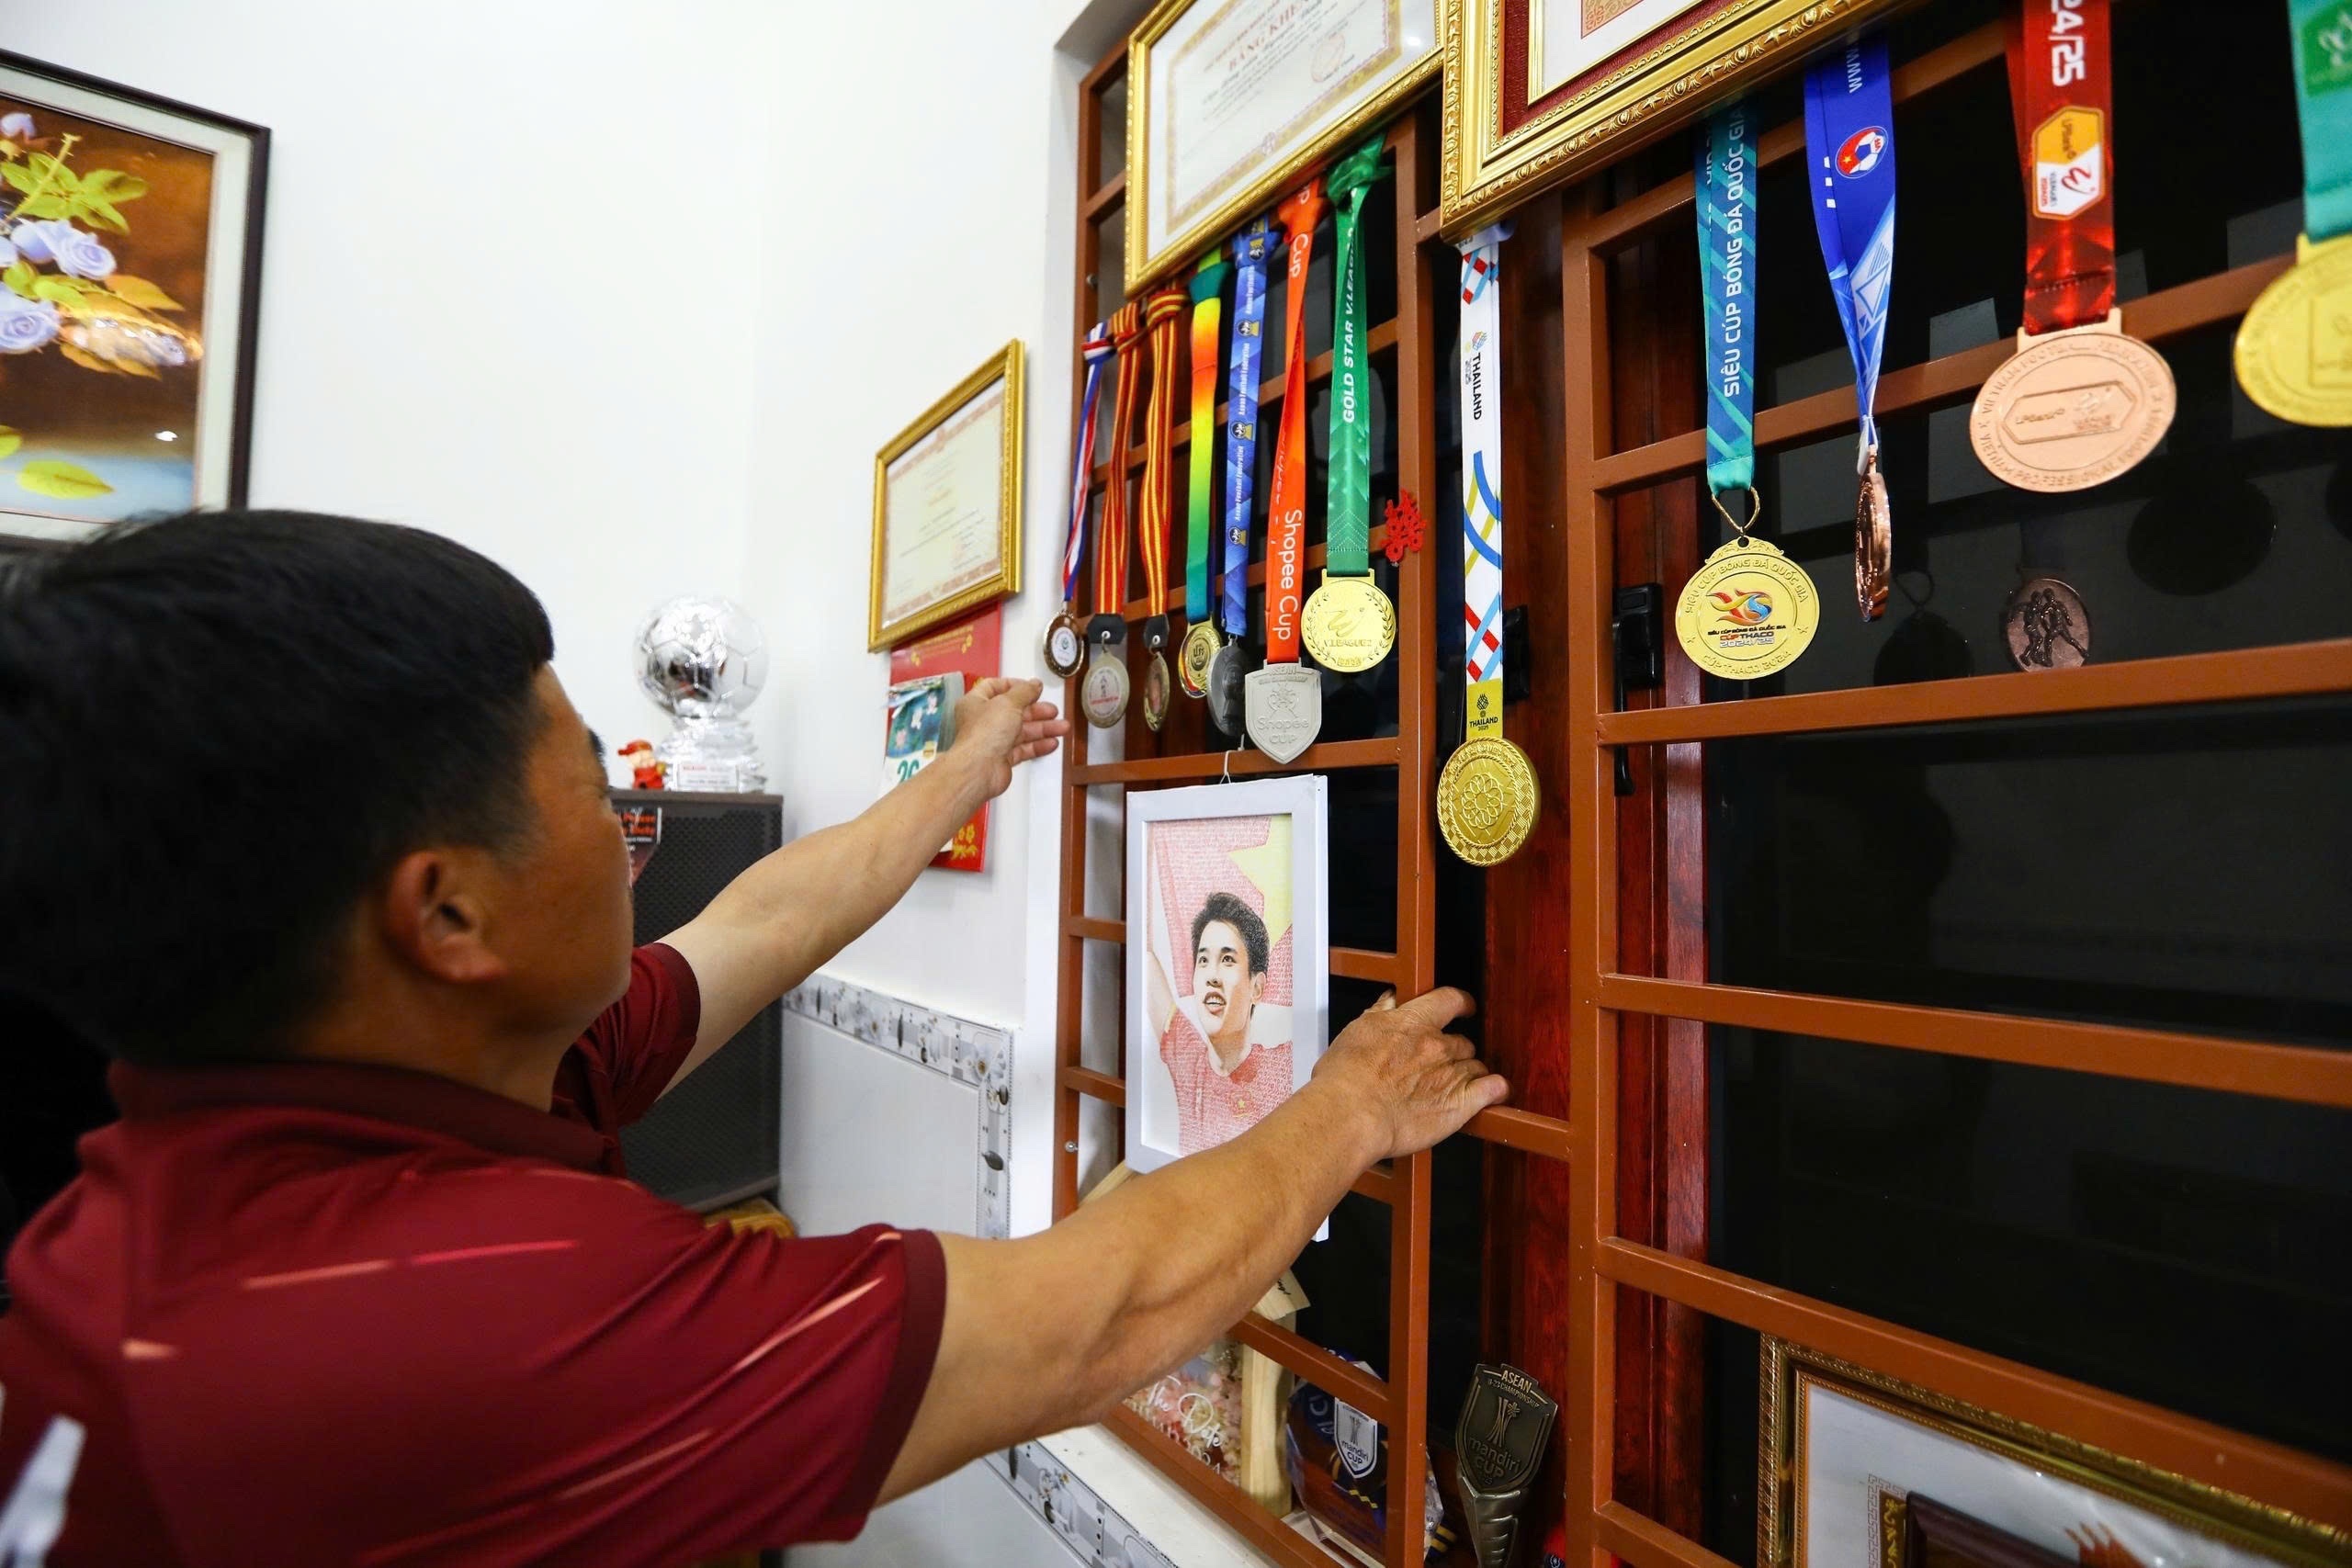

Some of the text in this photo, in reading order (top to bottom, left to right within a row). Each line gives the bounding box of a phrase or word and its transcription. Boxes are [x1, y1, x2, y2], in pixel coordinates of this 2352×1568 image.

[1722, 142, 1744, 202] QUỐC
[1726, 203, 1744, 235] ĐÁ
[1289, 233, 1308, 278] Cup
[1726, 232, 1743, 298] BÓNG
[1724, 299, 1742, 344] CÚP
[1343, 325, 1354, 368] STAR
[1472, 352, 1482, 421] THAILAND
[1724, 347, 1740, 398] SIÊU
[1342, 373, 1355, 423] GOLD
[1281, 509, 1303, 590] Shopee
[1272, 595, 1298, 640] Cup
[1720, 631, 1774, 641] CÚP THACO
[1257, 715, 1309, 733] Shopee
[1469, 716, 1498, 728] THAILAND
[1501, 1370, 1532, 1393] ASEAN
[1346, 1450, 1363, 1464] CUP
[1470, 1437, 1521, 1473] mandiri
[1475, 1455, 1505, 1478] CUP
